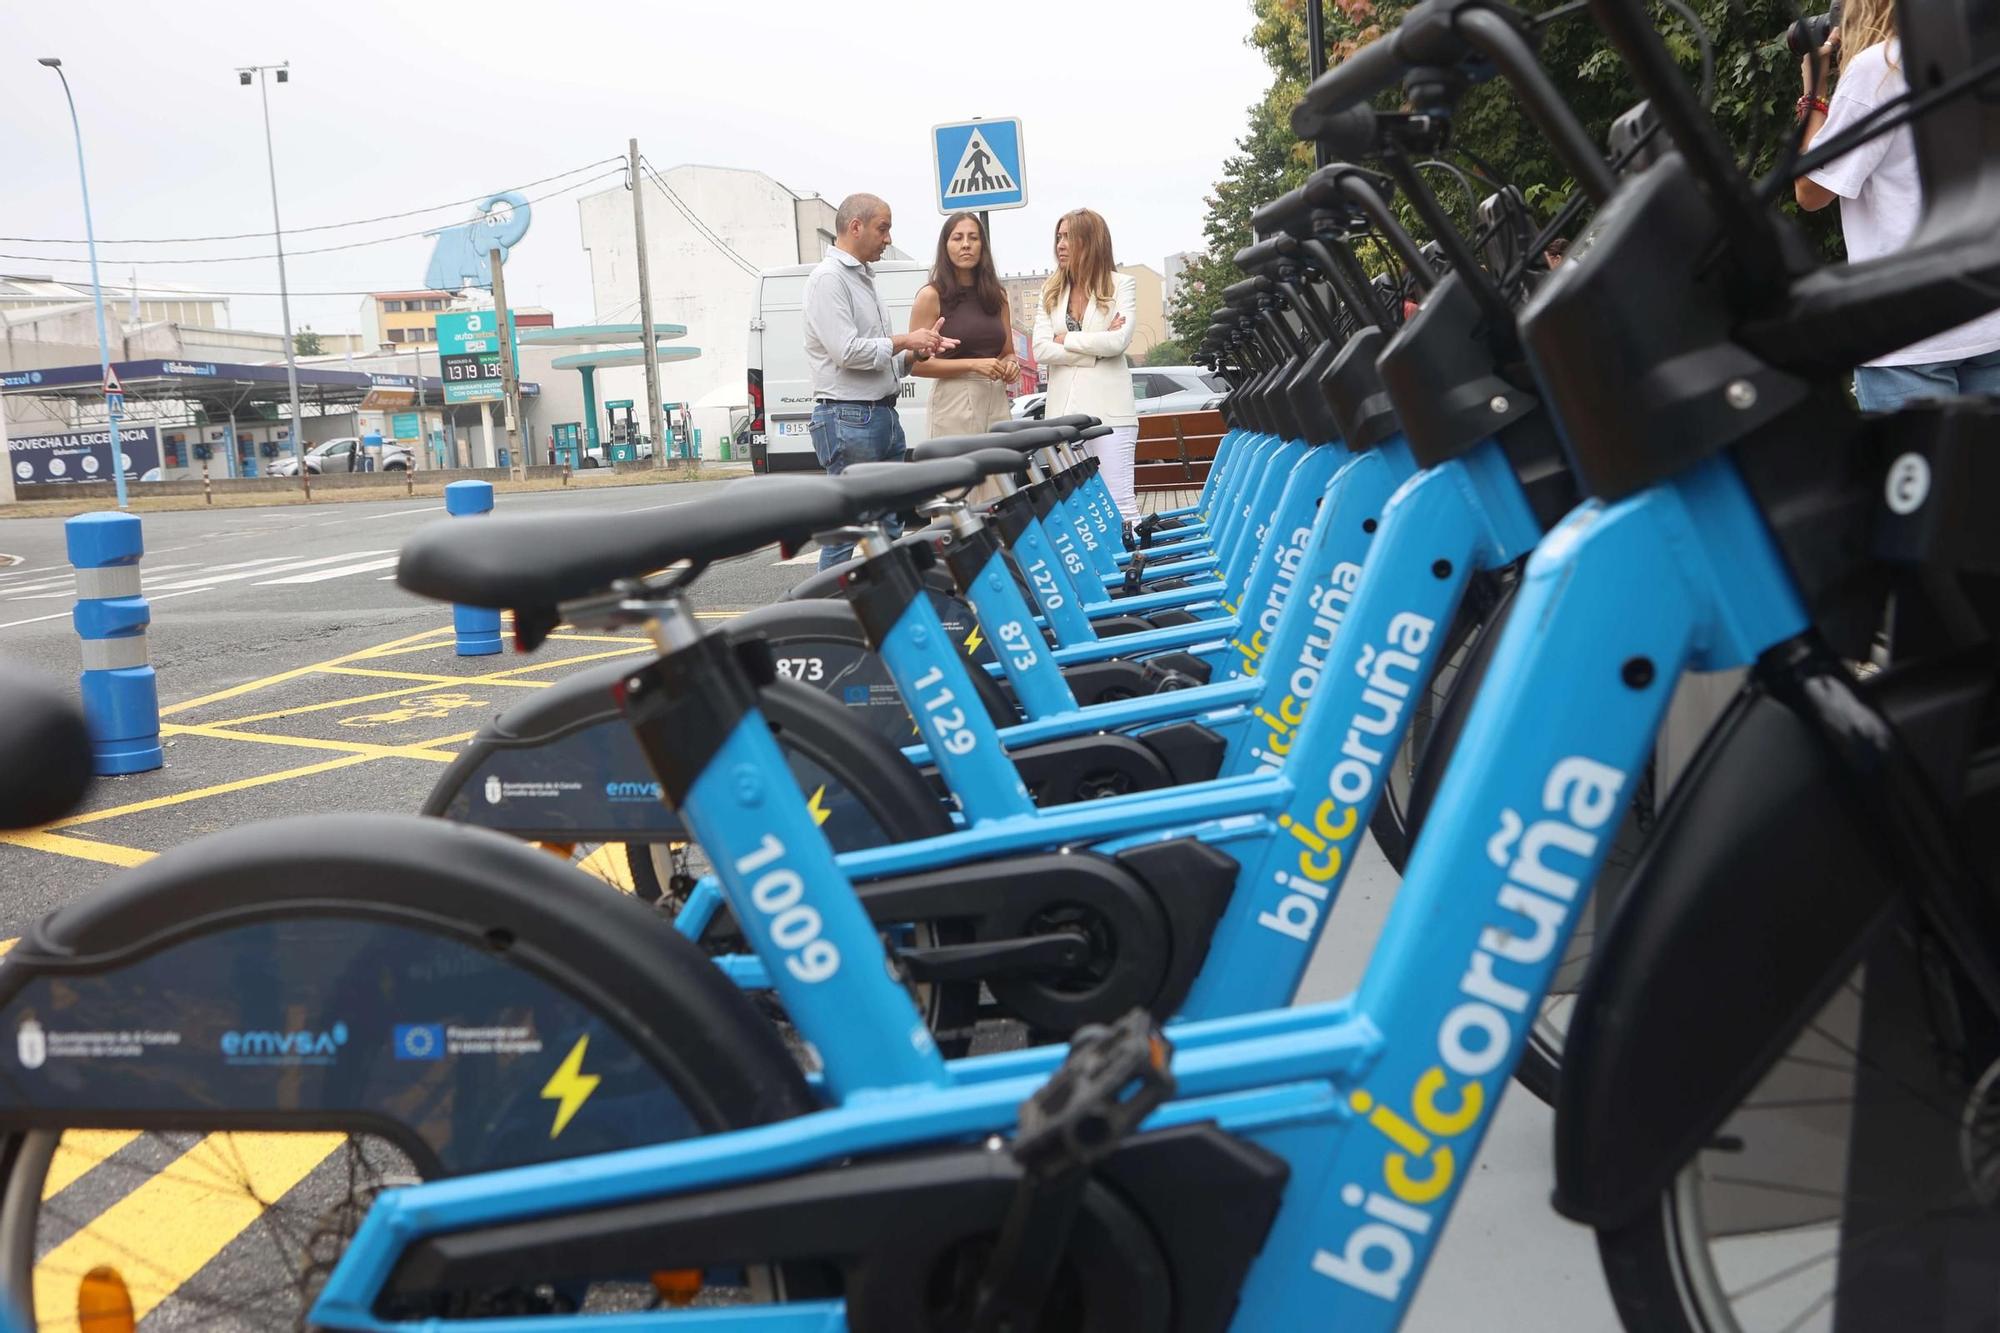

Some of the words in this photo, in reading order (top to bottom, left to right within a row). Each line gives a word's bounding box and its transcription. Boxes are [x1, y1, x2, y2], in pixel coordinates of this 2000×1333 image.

[901, 382, 916, 398] IAT
[8, 437, 63, 451] ROVECHA
[63, 436, 80, 447] LA
[81, 429, 149, 445] EXCENCIA
[1056, 533, 1084, 575] 1165
[1073, 516, 1099, 551] 1204
[1029, 559, 1064, 610] 1270
[1230, 527, 1312, 682] icicoruña
[776, 658, 824, 681] 873
[999, 621, 1037, 671] 873
[914, 666, 977, 755] 1129
[606, 781, 659, 796] emvs
[1258, 610, 1436, 942] bicicoruña
[735, 832, 841, 984] 1009
[1312, 755, 1626, 1301] bicicoruña
